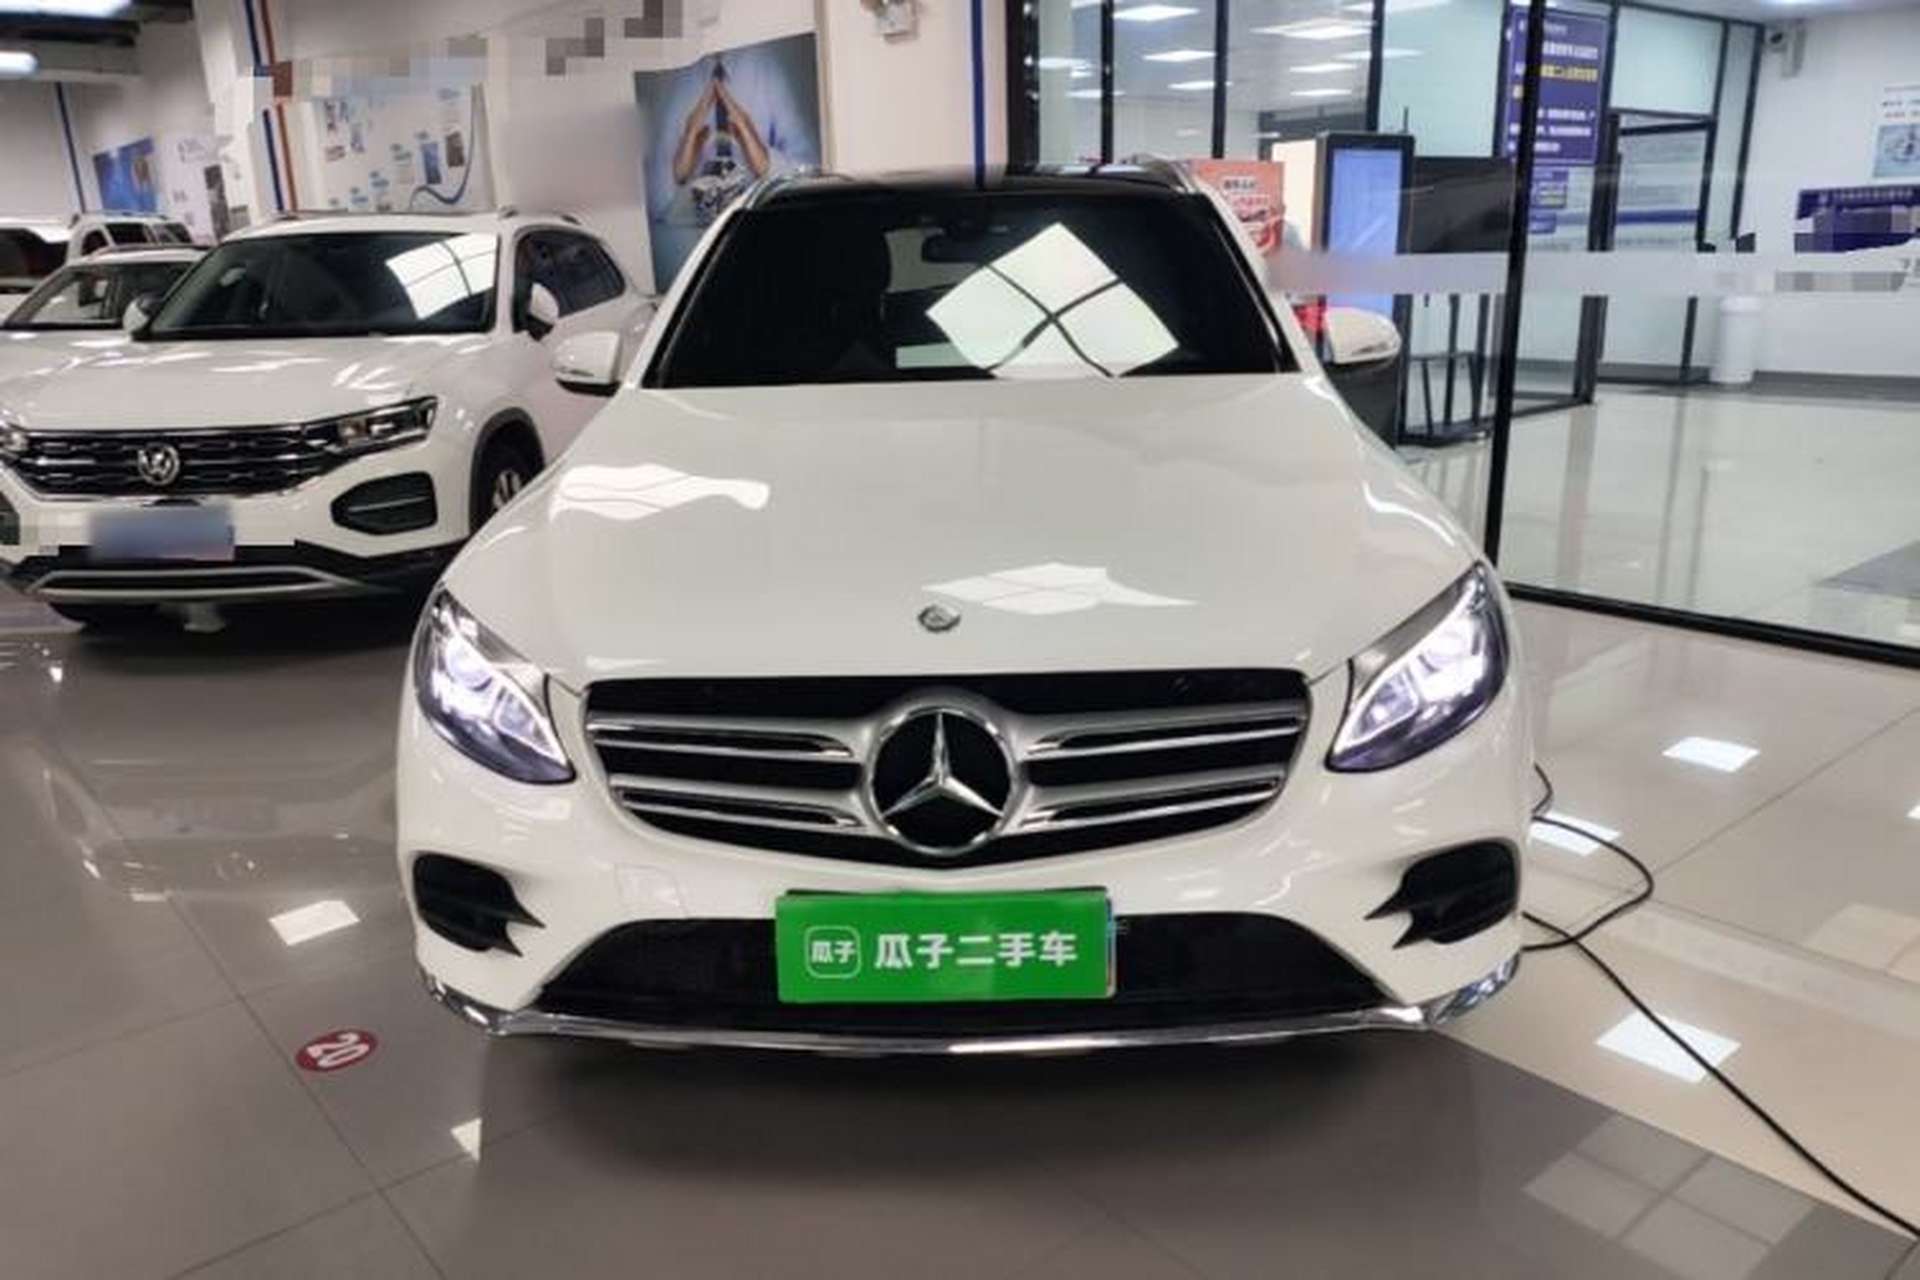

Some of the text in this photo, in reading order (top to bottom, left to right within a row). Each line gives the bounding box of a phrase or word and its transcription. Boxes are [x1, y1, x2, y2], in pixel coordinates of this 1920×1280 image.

[811, 932, 1078, 968] 瓜子 瓜子二手车
[306, 1032, 370, 1067] 20
